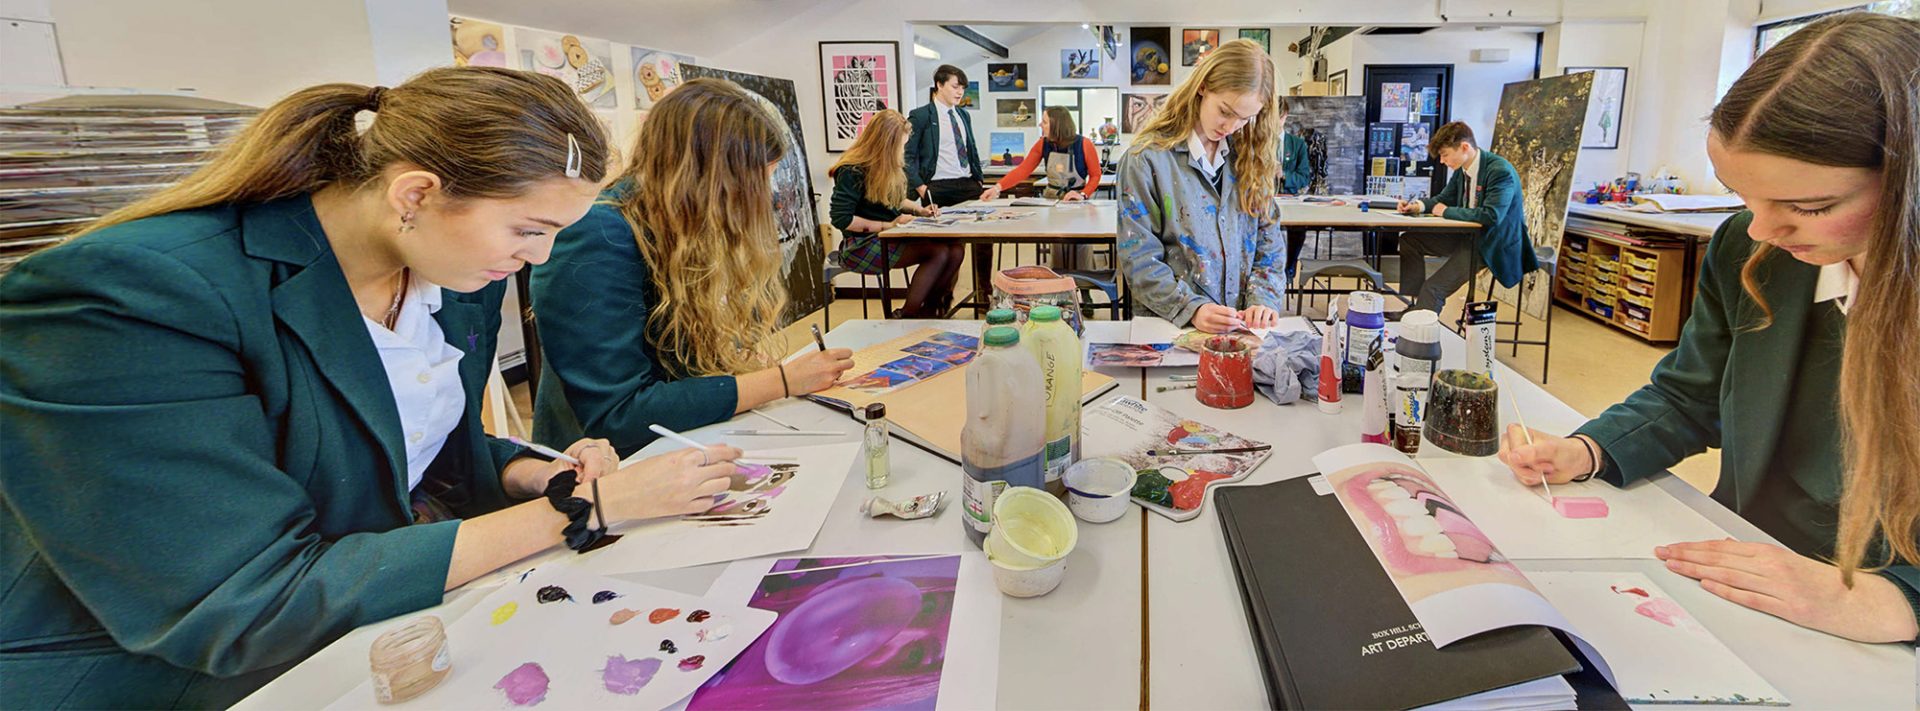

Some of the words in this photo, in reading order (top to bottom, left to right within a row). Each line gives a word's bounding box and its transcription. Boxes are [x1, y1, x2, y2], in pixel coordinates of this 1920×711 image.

[1371, 629, 1390, 639] BOX
[1389, 625, 1408, 634] HILL
[1361, 642, 1384, 656] ART
